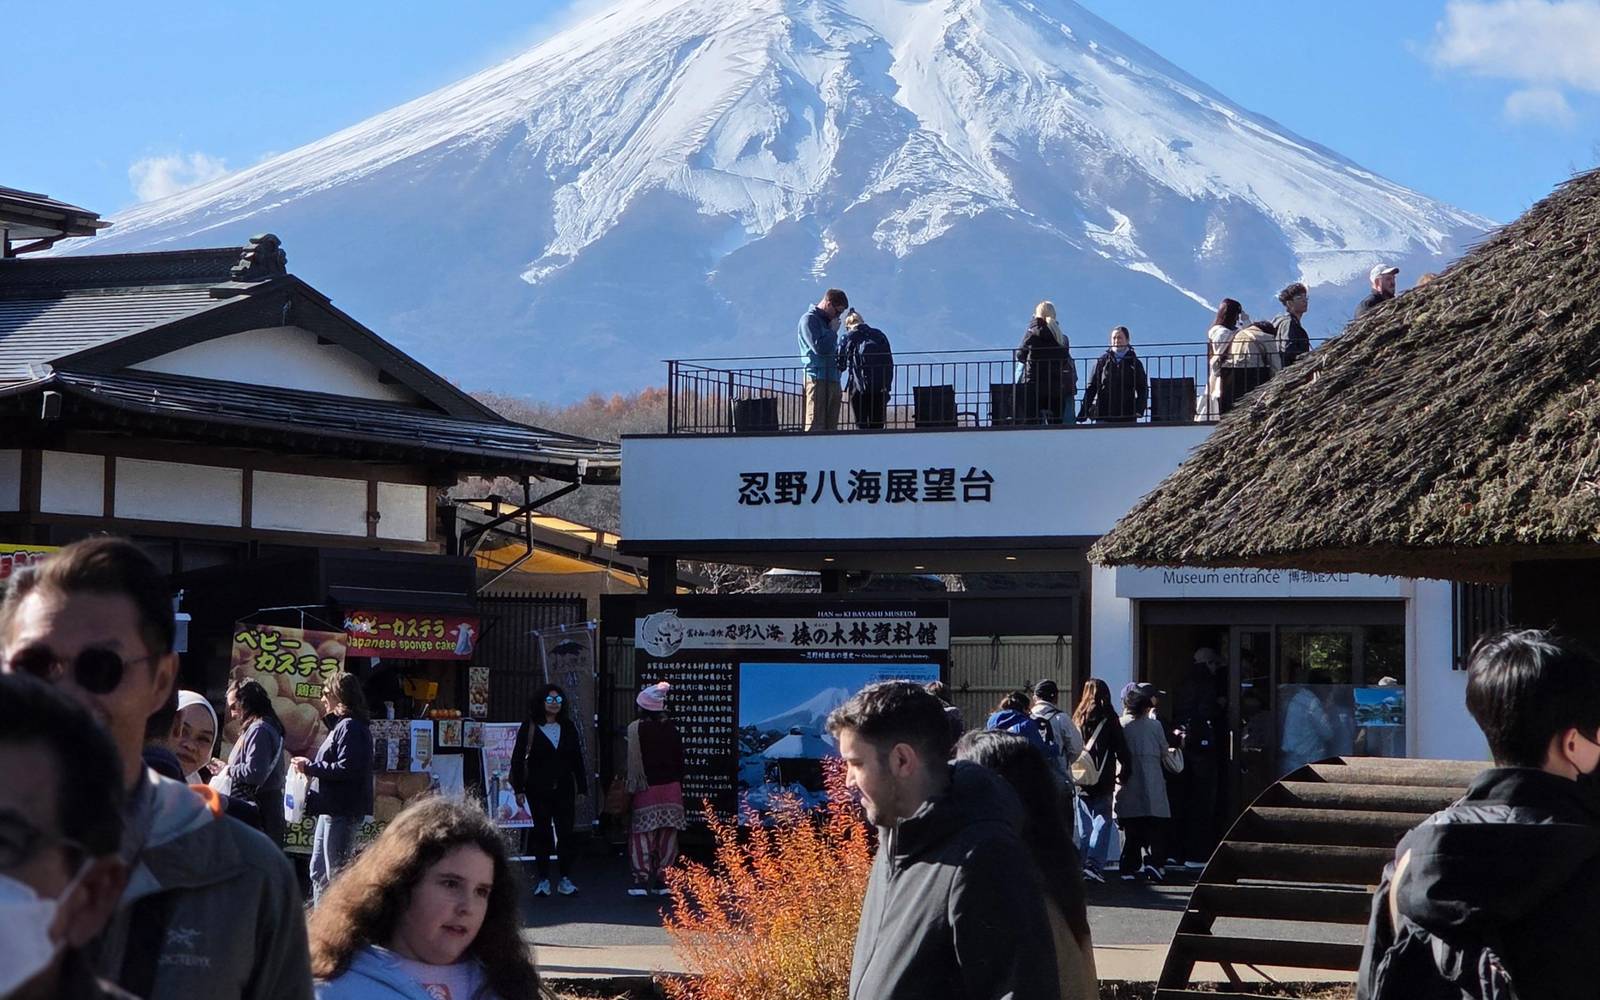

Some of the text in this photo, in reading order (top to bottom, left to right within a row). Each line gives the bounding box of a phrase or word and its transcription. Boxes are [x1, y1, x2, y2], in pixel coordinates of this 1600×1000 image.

[738, 467, 995, 505] 忍野八海展望台
[1163, 571, 1219, 584] Museum
[1223, 572, 1281, 584] entrance
[236, 628, 301, 652] ベビー
[346, 636, 457, 652] Japanese sponge cake
[256, 650, 340, 680] カステラ
